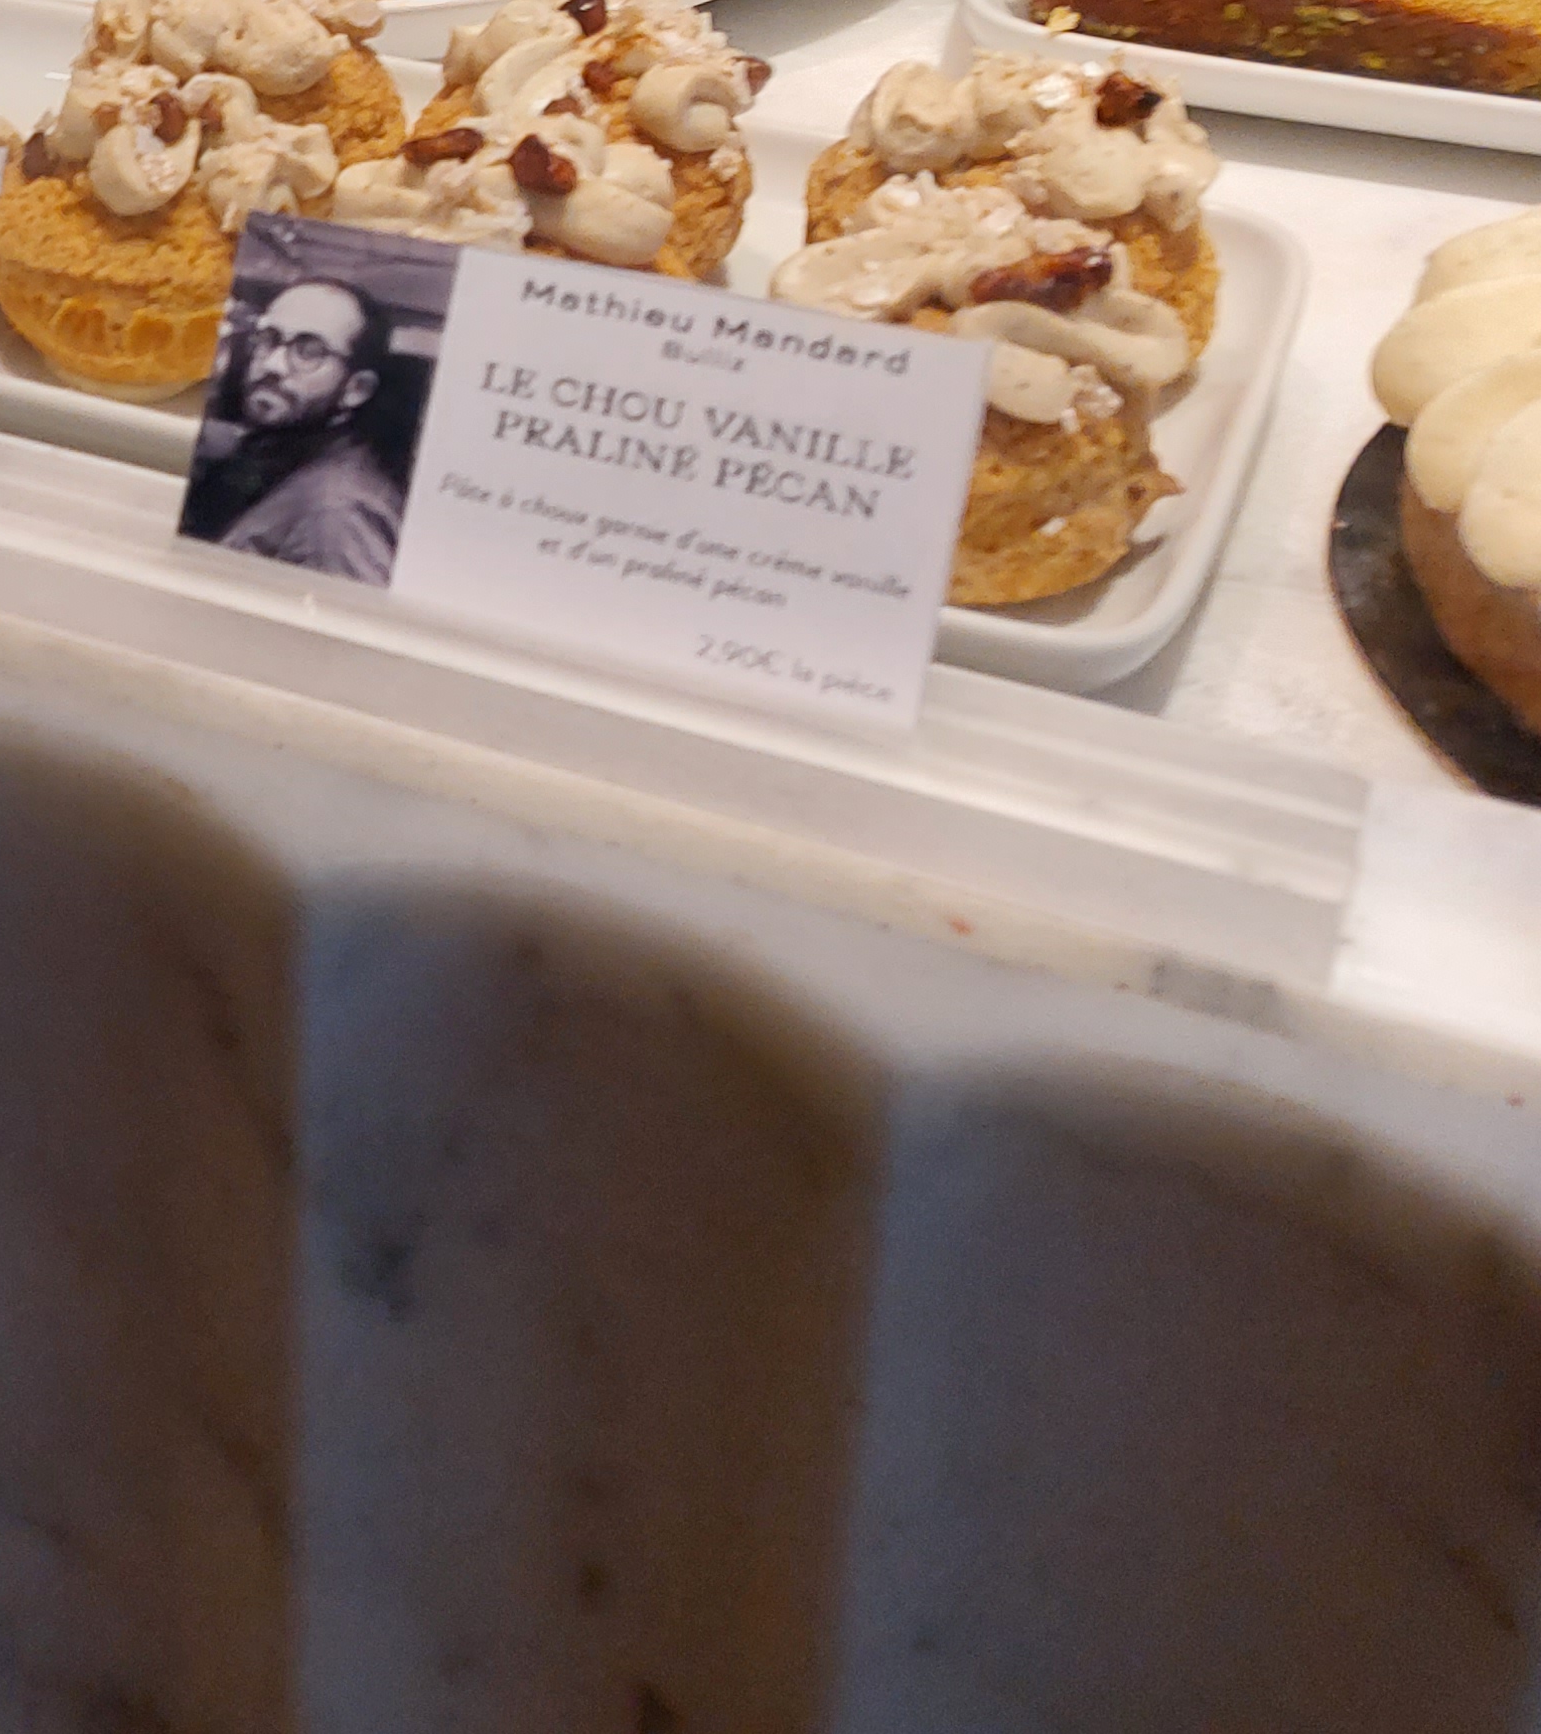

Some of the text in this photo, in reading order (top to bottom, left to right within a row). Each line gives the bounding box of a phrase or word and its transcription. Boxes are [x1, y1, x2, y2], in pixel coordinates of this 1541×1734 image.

[521, 280, 909, 375] Mathieu Mandard
[482, 362, 912, 479] LE CHOU VANILLE
[493, 410, 698, 480] PRALINÉ
[441, 475, 911, 599] Pâte à choux garnie d'une crème vanille
[538, 539, 562, 554] et
[567, 540, 618, 566] d'un
[620, 559, 705, 589] praliné
[696, 634, 894, 703] 2,90€ la pièce
